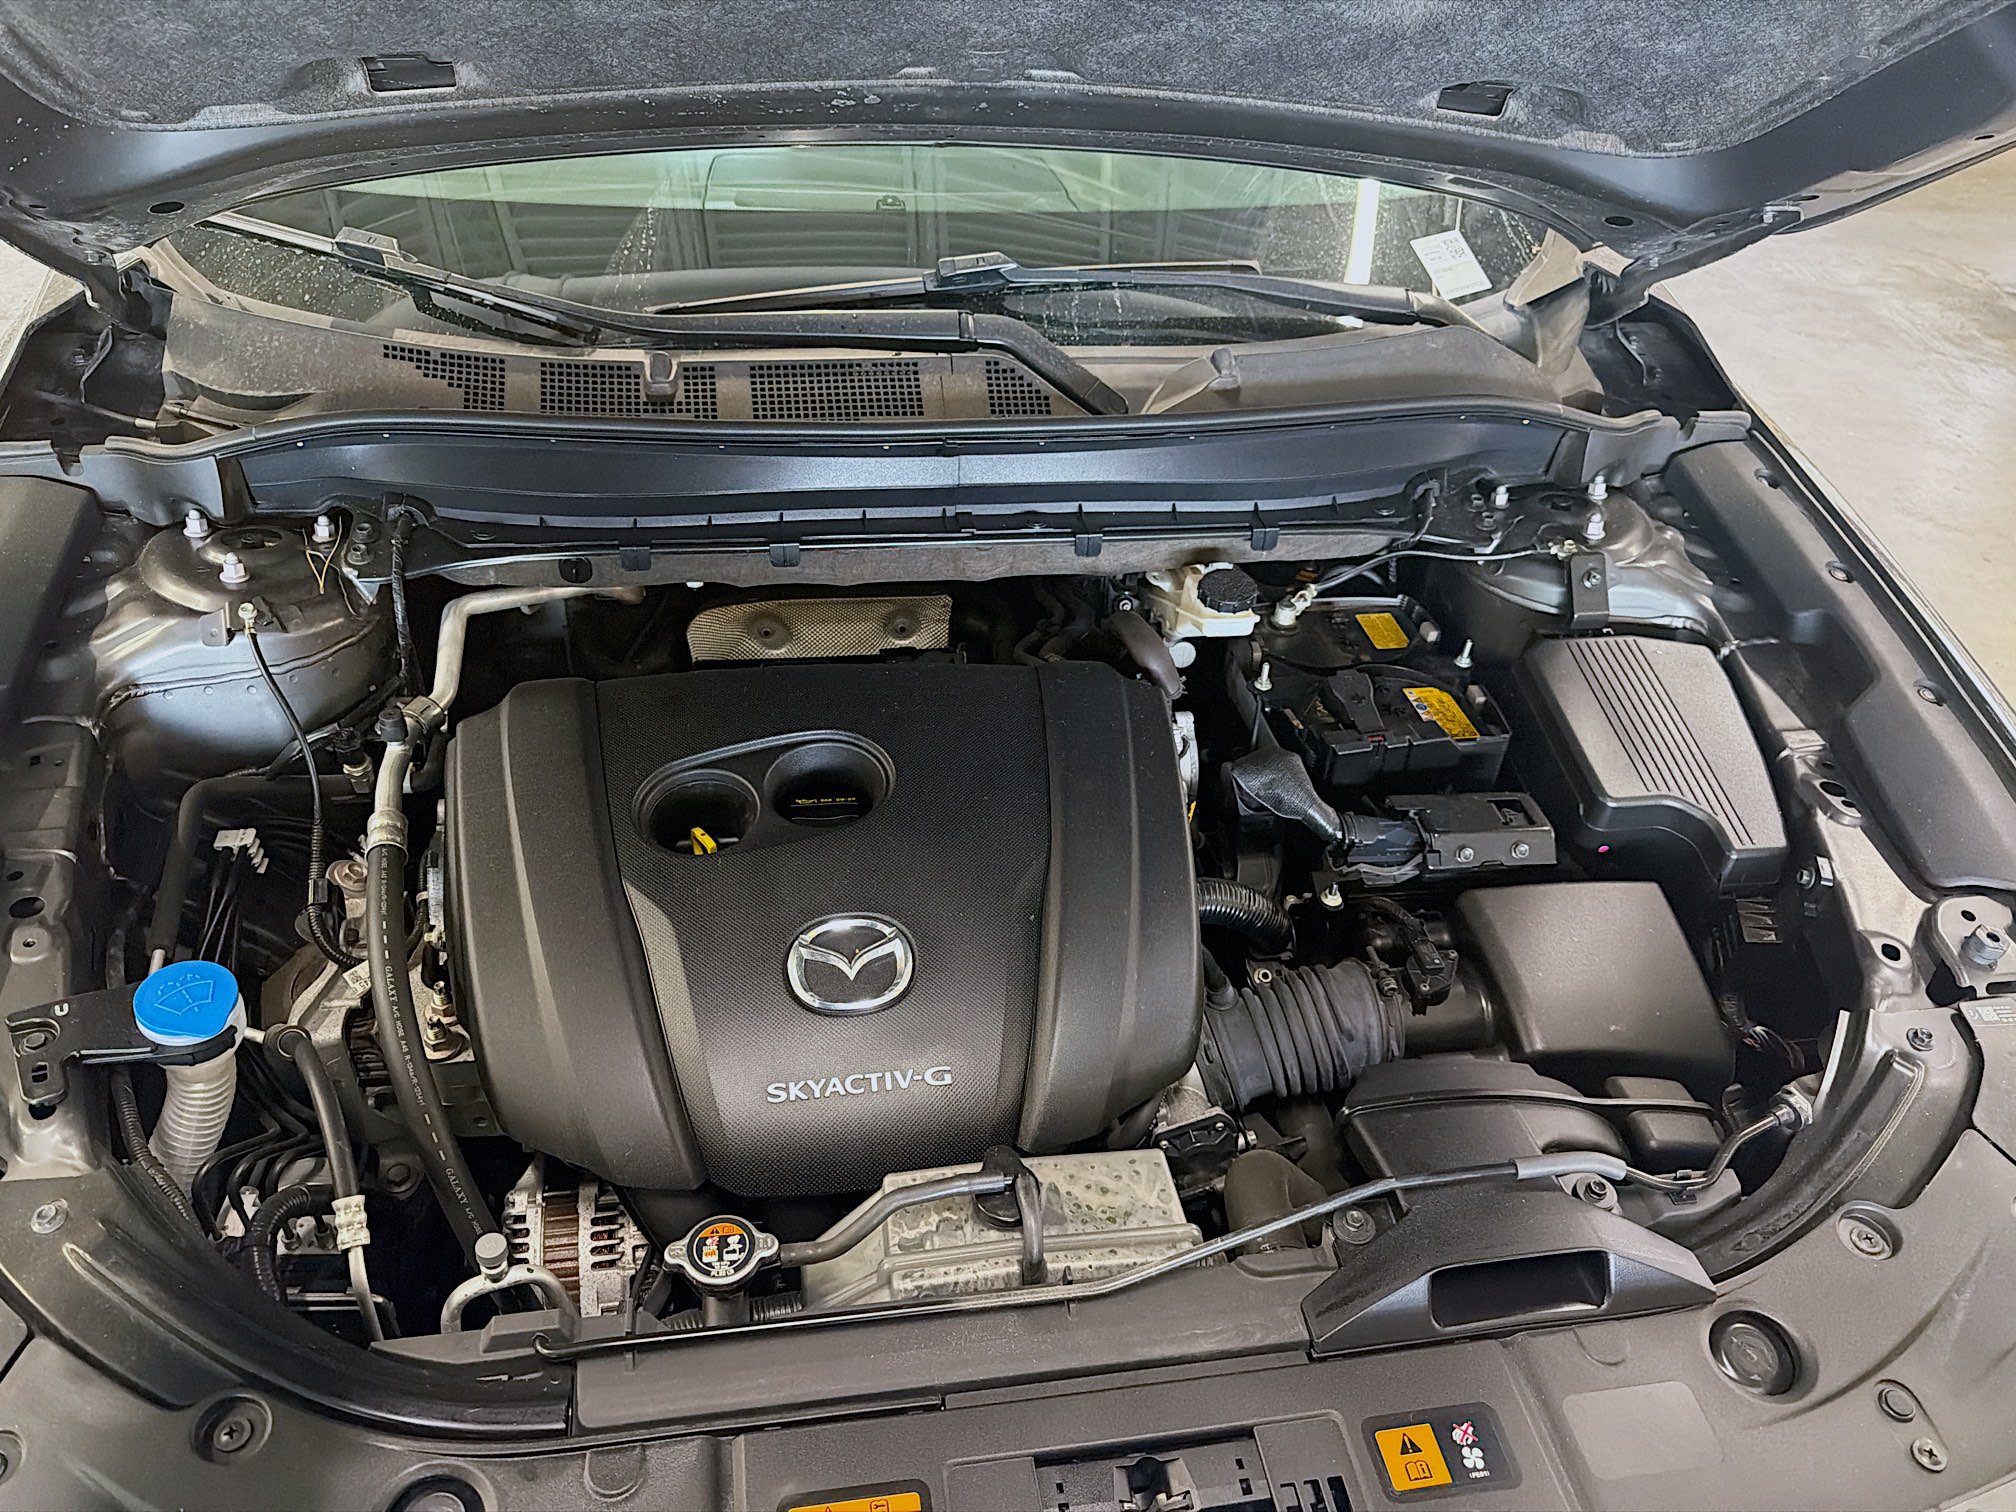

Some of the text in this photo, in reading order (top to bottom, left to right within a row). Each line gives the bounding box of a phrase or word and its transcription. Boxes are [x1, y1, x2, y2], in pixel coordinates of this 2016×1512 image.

[385, 965, 399, 1002] GALAXY
[392, 1005, 401, 1018] A/C
[396, 1020, 406, 1038] HOSE
[766, 1066, 953, 1104] SKYACTIV-G
[445, 1168, 469, 1205] GALAXY
[471, 1220, 483, 1235] HOSE
